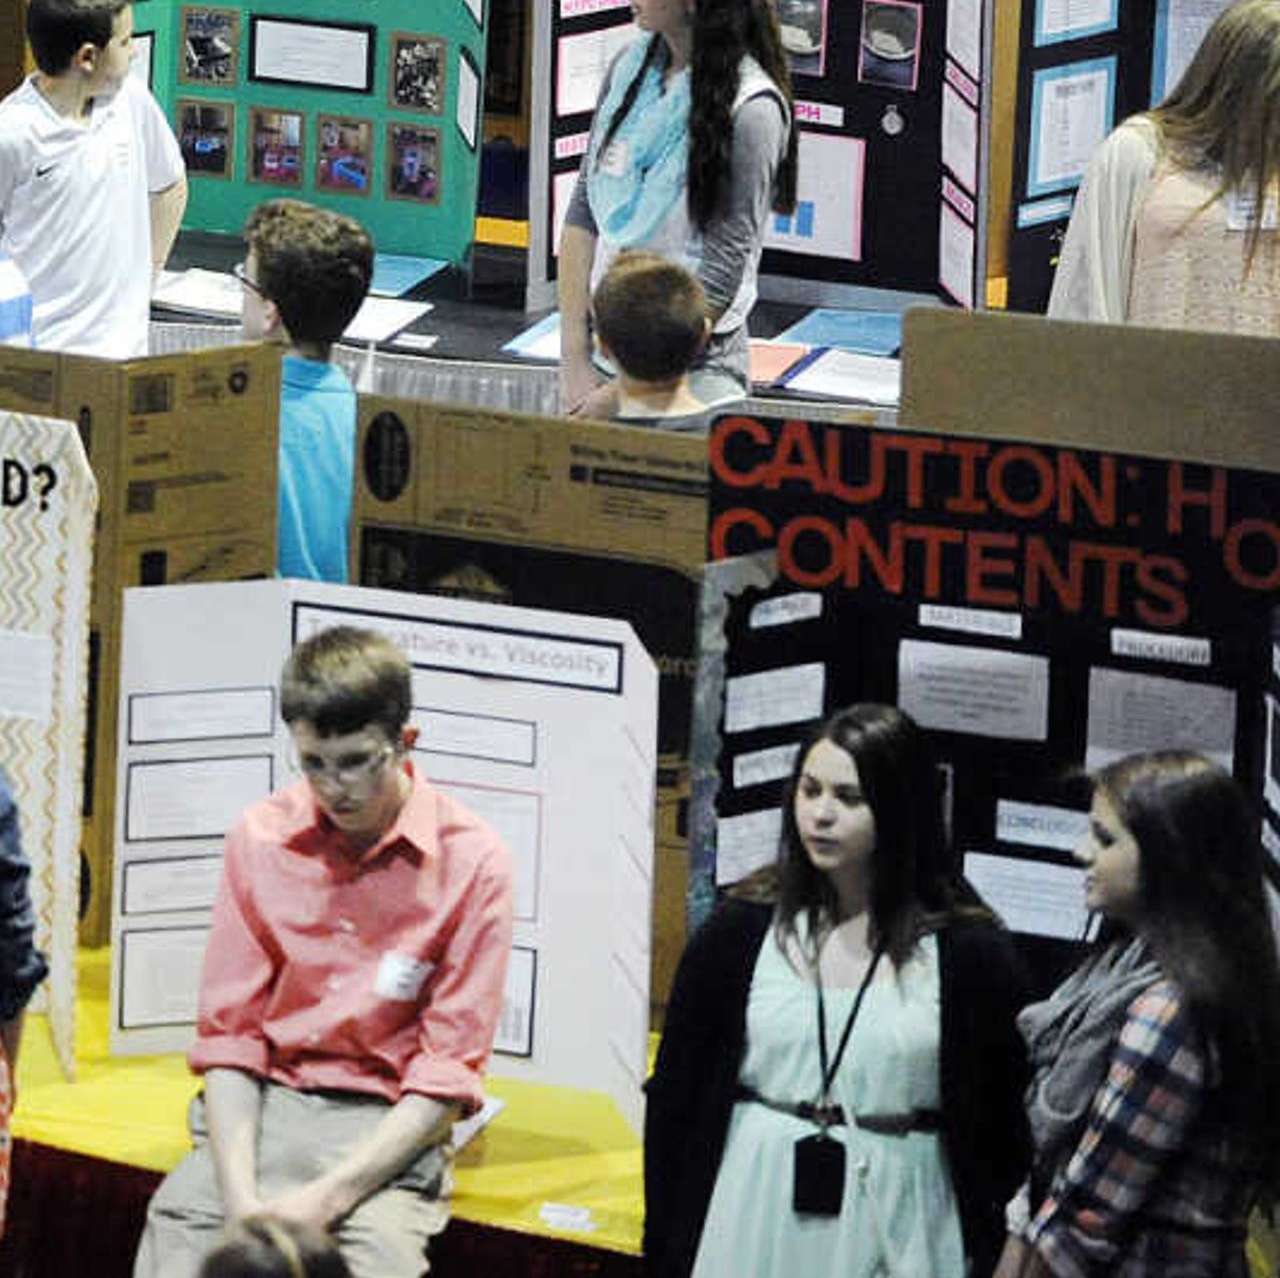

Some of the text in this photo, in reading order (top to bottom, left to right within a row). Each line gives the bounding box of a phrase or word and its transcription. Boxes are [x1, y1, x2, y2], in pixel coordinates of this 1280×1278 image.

[708, 415, 1139, 525] CAUTION:
[711, 509, 1188, 624] CONTENTS
[506, 639, 607, 680] Viscosity
